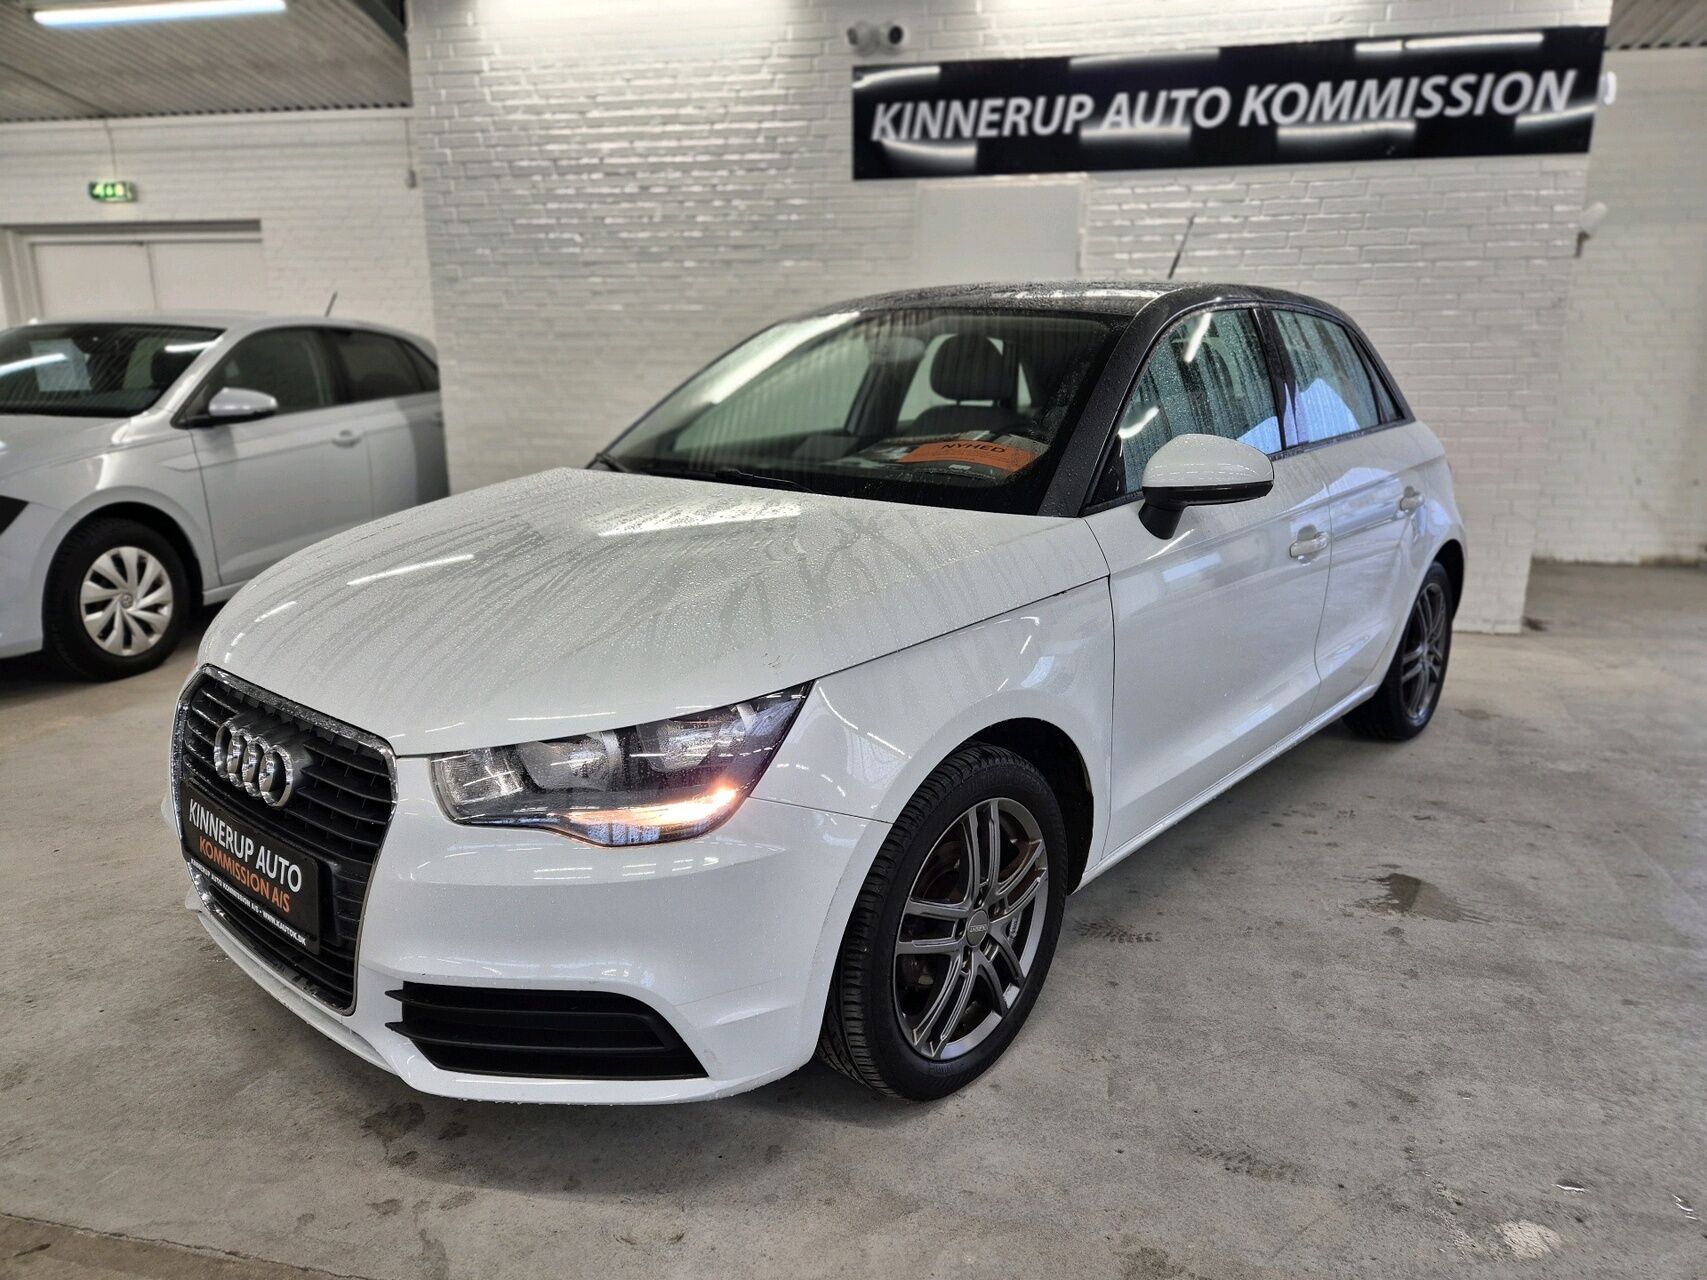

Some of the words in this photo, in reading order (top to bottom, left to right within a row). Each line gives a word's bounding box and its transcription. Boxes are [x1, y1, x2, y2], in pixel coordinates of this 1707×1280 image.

[870, 93, 1095, 142] KINNERUP
[1100, 86, 1231, 130] AUTO
[1238, 69, 1578, 128] KOMMISSION
[942, 442, 1006, 453] NYHED
[189, 798, 254, 863] KINNERUP
[255, 845, 303, 893] AUTO
[199, 837, 270, 900] KOMMISSION
